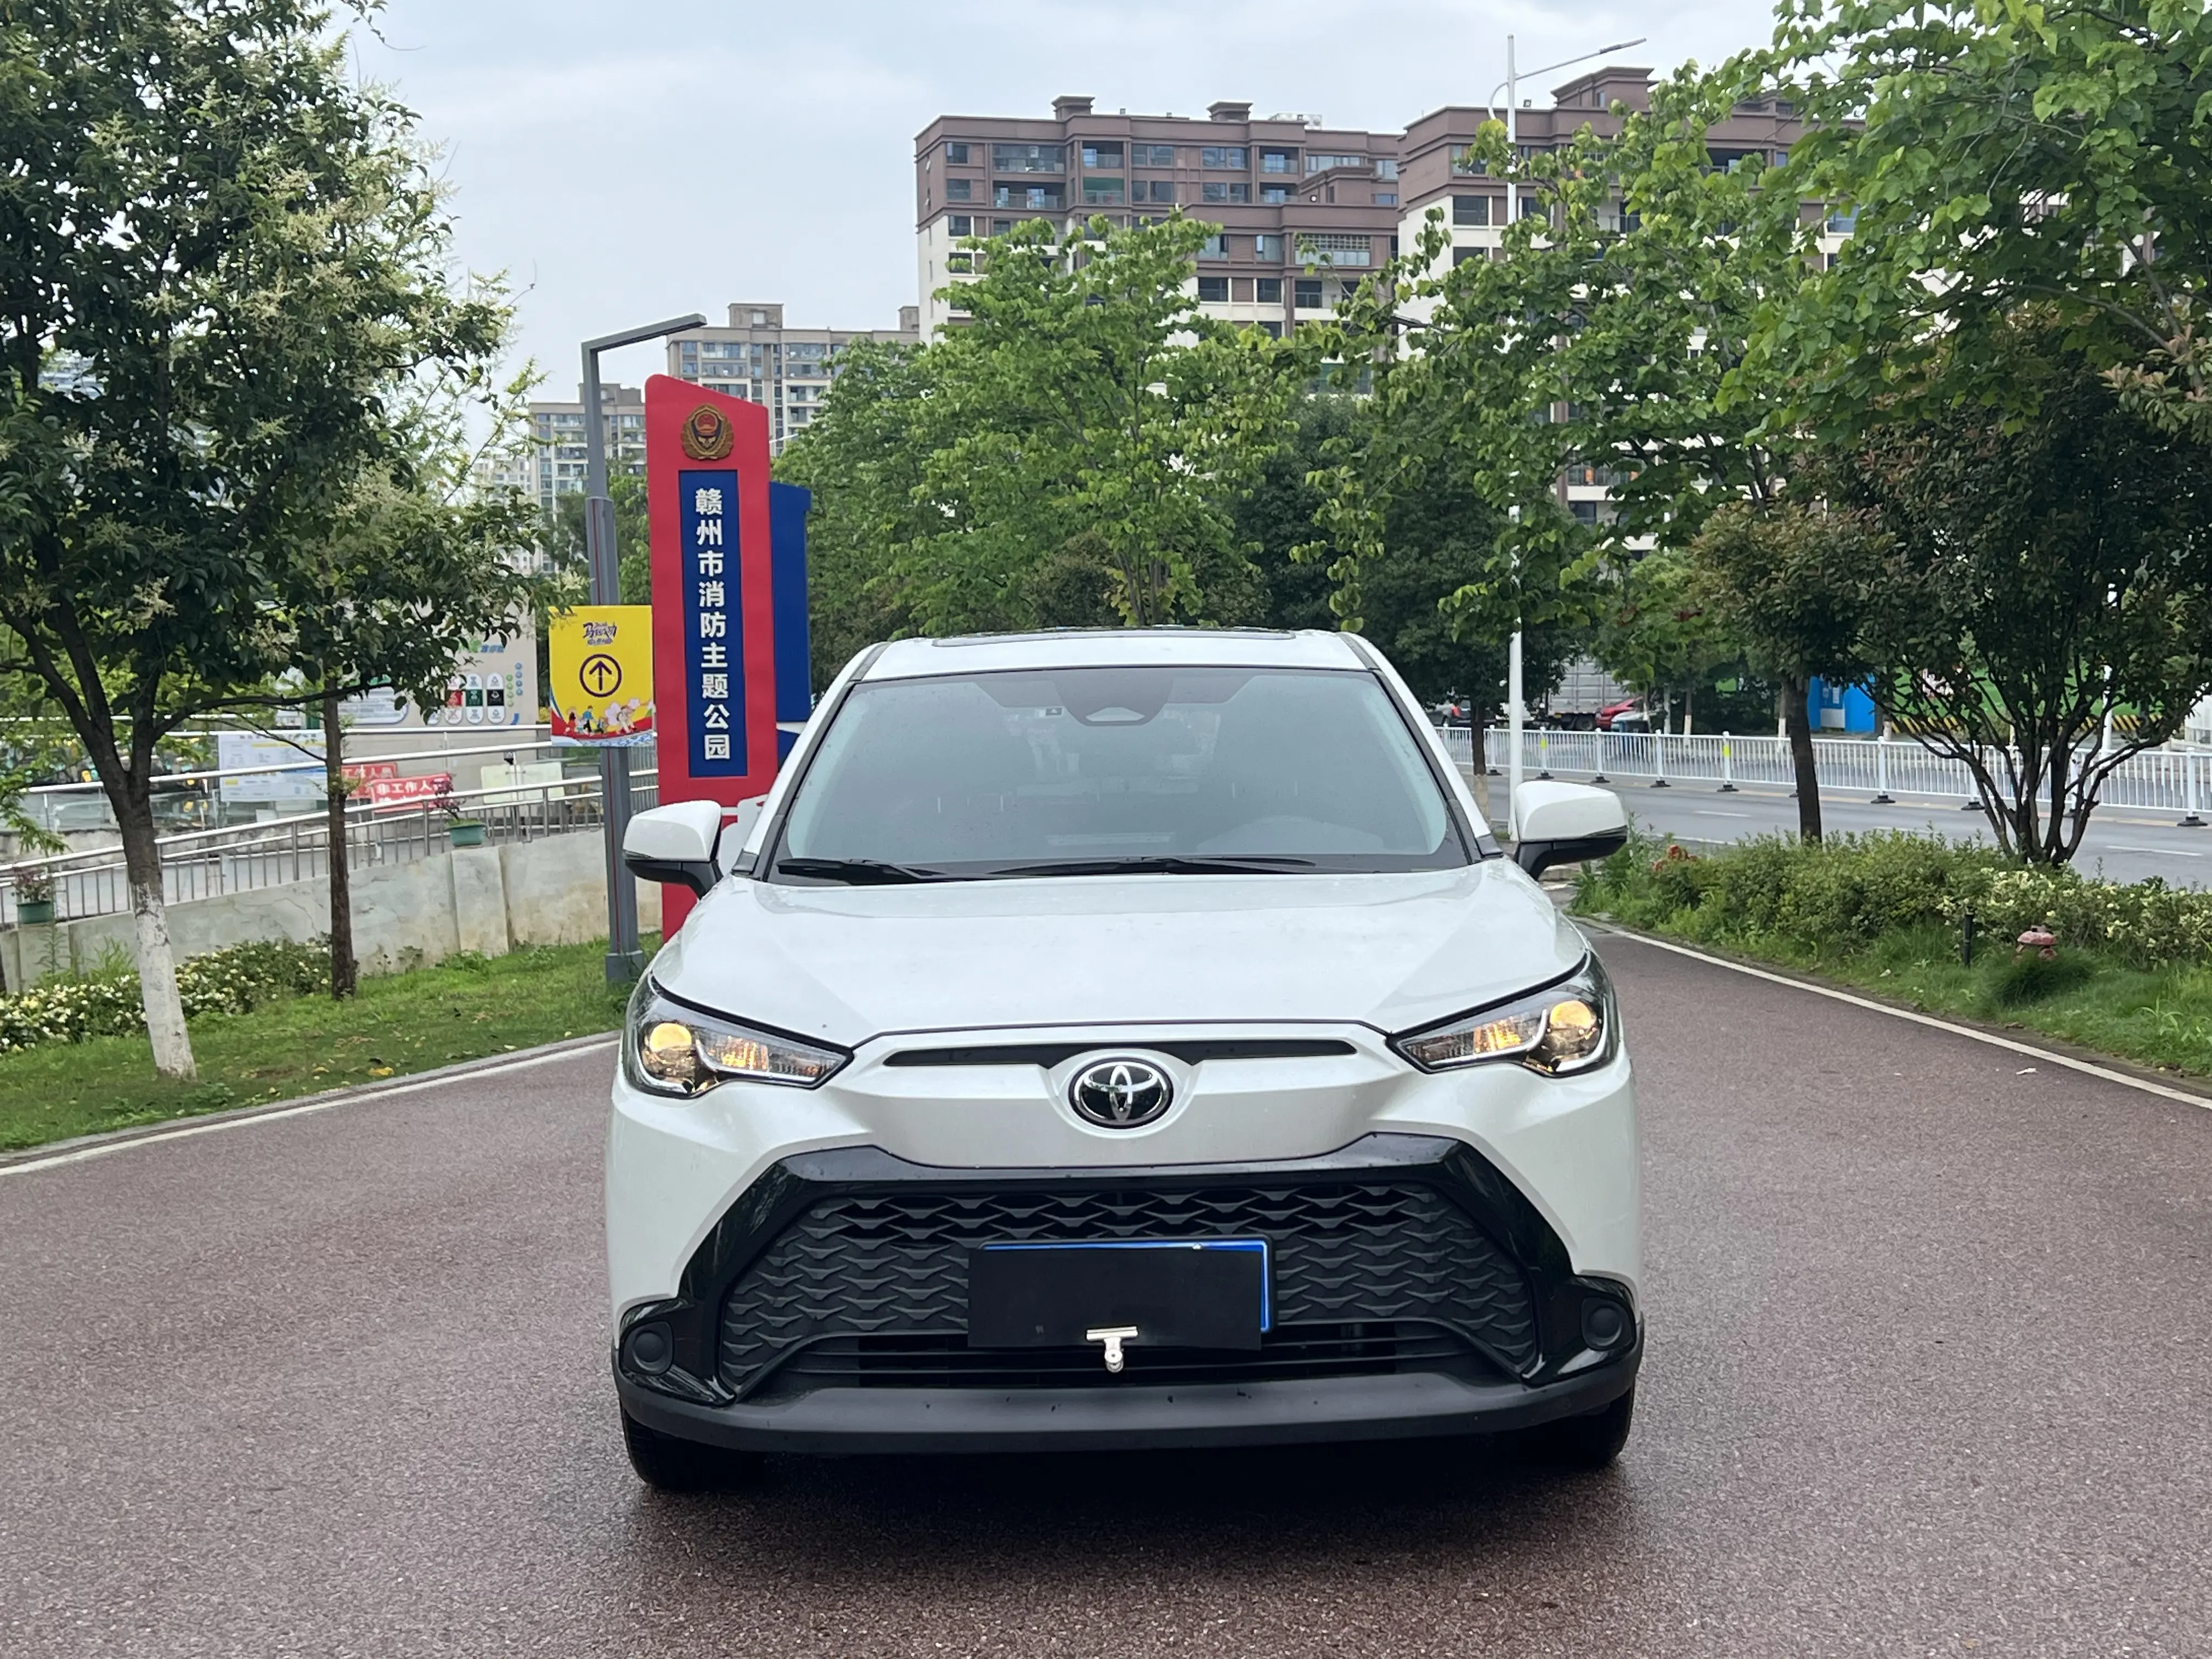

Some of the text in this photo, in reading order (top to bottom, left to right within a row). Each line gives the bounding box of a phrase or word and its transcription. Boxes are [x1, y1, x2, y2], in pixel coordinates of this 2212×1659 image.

[695, 488, 730, 760] 赣州市消防主题公园
